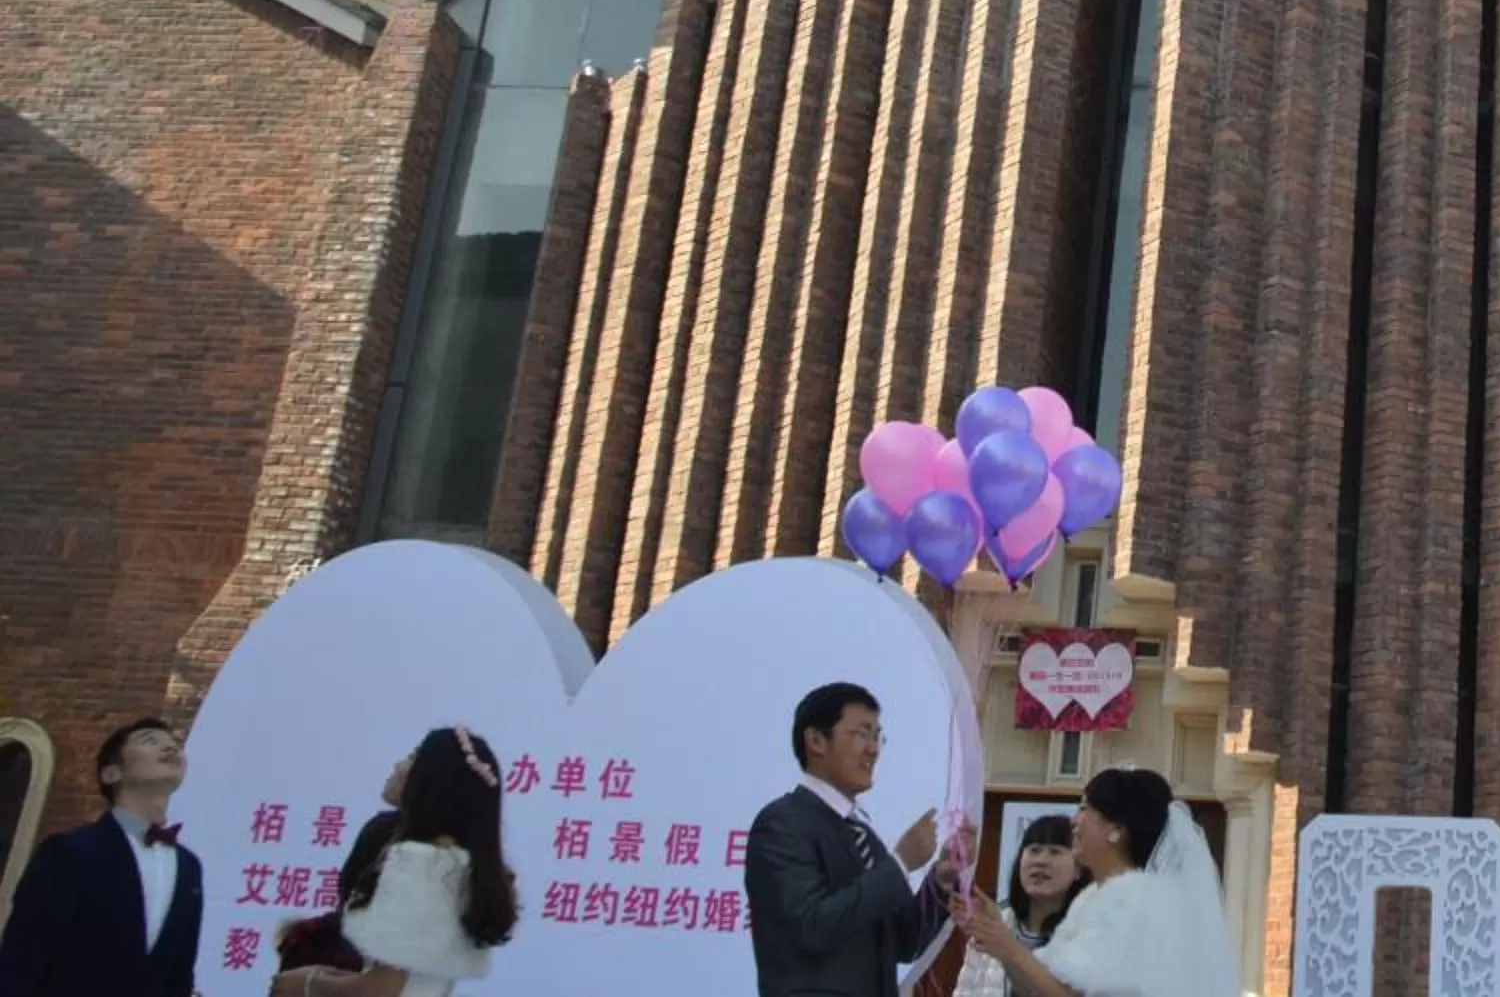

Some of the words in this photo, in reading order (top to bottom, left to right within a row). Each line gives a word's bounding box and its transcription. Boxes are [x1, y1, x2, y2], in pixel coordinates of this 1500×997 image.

[505, 753, 637, 800] 办单位
[541, 880, 754, 933] 纽约纽约婚
[223, 926, 262, 971] 黎
